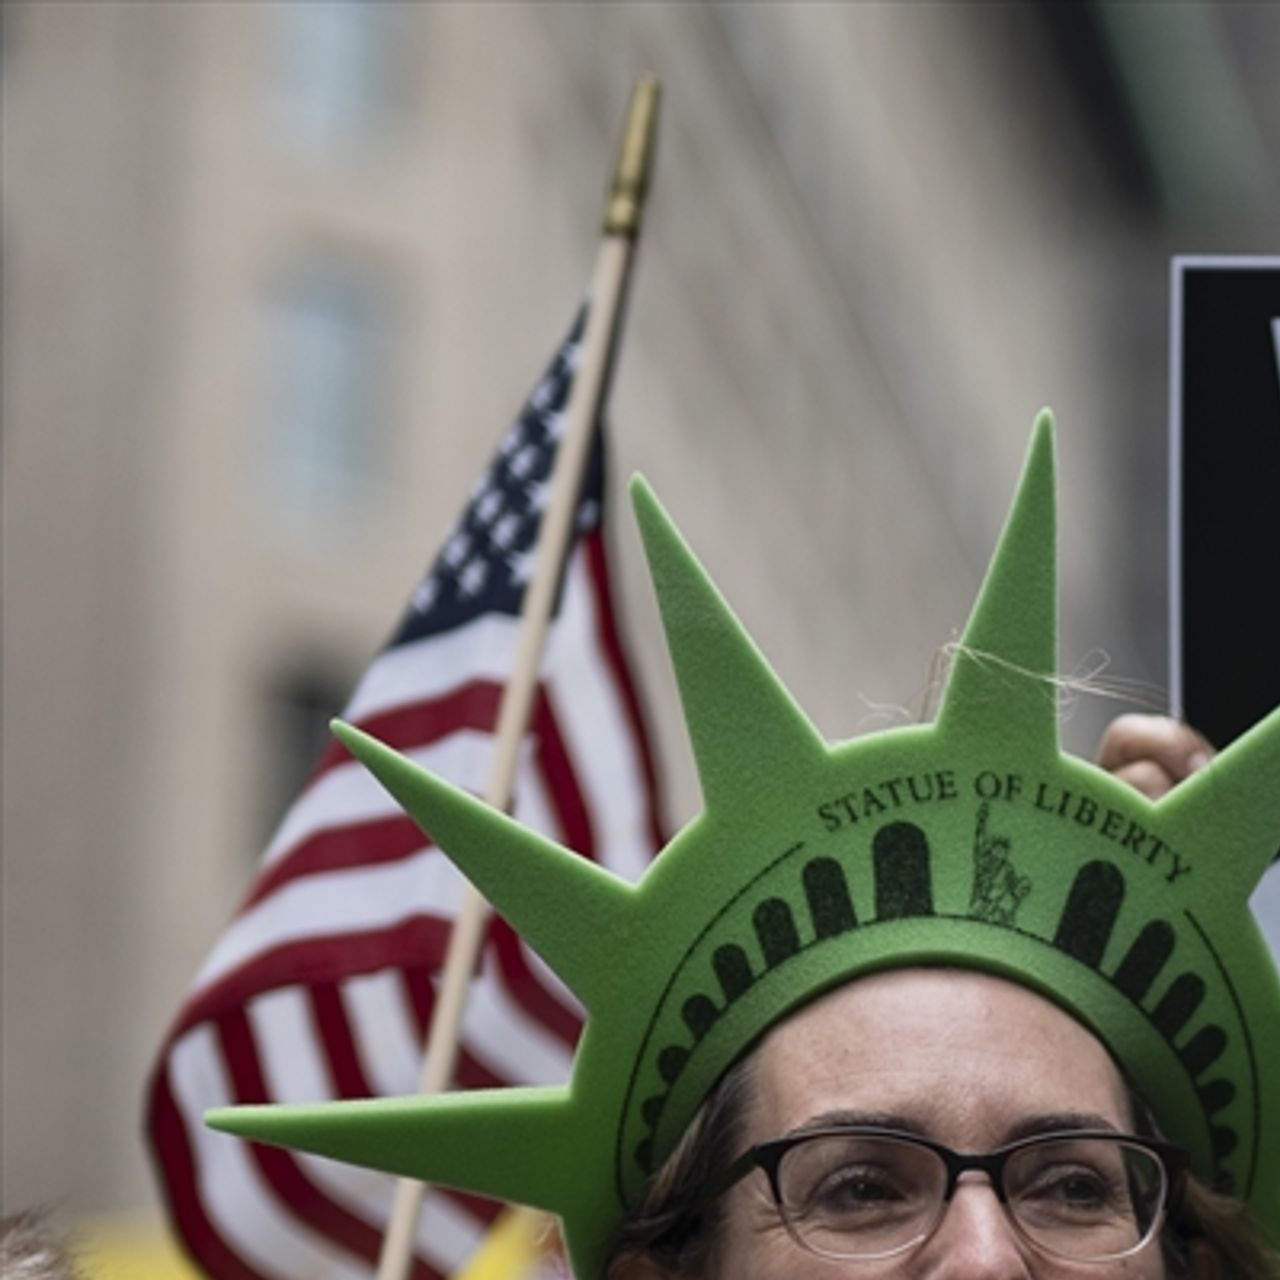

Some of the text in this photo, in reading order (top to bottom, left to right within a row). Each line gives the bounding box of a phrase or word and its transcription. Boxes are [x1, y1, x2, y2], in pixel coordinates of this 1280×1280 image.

[817, 769, 1193, 886] STATUE OF LIBERTY
